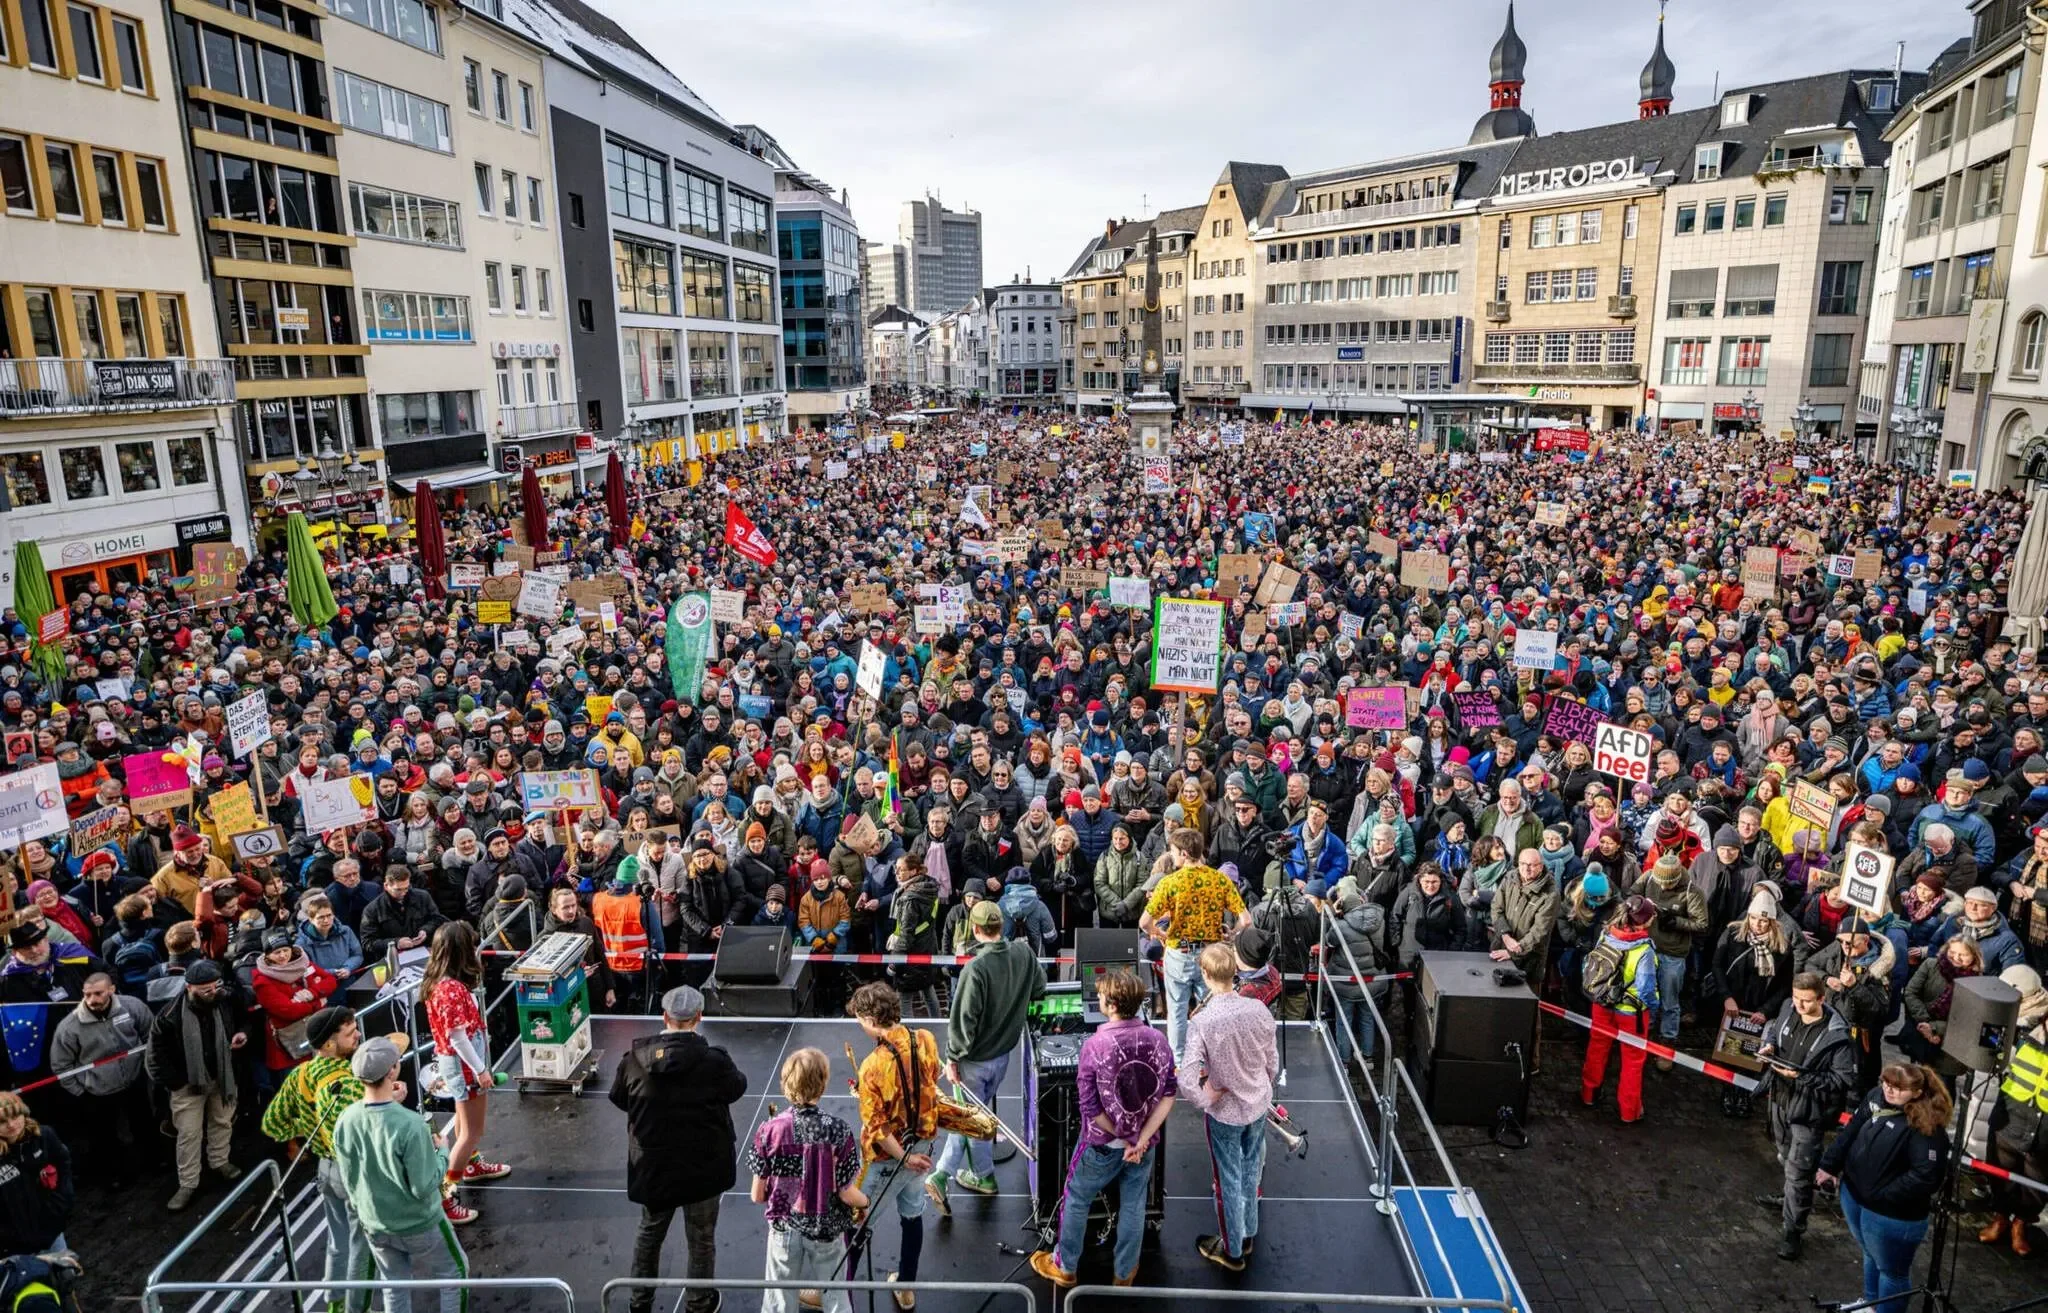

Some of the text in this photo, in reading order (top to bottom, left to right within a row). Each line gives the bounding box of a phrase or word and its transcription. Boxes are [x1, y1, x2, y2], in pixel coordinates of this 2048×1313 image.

[1501, 156, 1645, 194] METROPOL
[511, 343, 551, 357] LEICA
[124, 366, 172, 375] RESTAURANT
[127, 374, 174, 389] DIM SUM
[1541, 389, 1572, 400] Thalia
[1145, 457, 1169, 466] NAZIS
[193, 521, 223, 534] DIM SUM
[1402, 554, 1445, 570] NAZIS
[2, 573, 10, 583] 5
[1065, 572, 1081, 580] HASS
[1162, 603, 1189, 613] KINDER
[1194, 617, 1216, 625] NICHT
[1279, 615, 1299, 625] BUNT
[1160, 625, 1182, 634] TIERE
[1174, 637, 1214, 648] MAN NICHT
[1158, 647, 1187, 662] NAZIS
[1169, 665, 1215, 680] MAN NICHT
[1351, 690, 1385, 700] BUNTE
[1455, 693, 1492, 705] HASS
[228, 704, 244, 717] DAS
[229, 705, 265, 727] RASSISMUS
[1352, 707, 1376, 715] STATT
[1460, 705, 1499, 714] IST KEINE
[233, 714, 269, 740] STEHT FÜR
[1461, 716, 1501, 727] MEINUNG
[1547, 711, 1598, 736] EGALIT
[1545, 723, 1572, 740] FCK
[1598, 728, 1650, 758] AfD
[1596, 750, 1647, 781] nee
[562, 771, 588, 782] SIND
[527, 782, 591, 799] BUNT
[0, 800, 29, 818] STATT
[75, 807, 118, 832] Deportation
[91, 820, 113, 837] KEINE
[78, 831, 121, 851] Alternative
[1858, 855, 1877, 867] FCK
[1857, 864, 1876, 873] AFD
